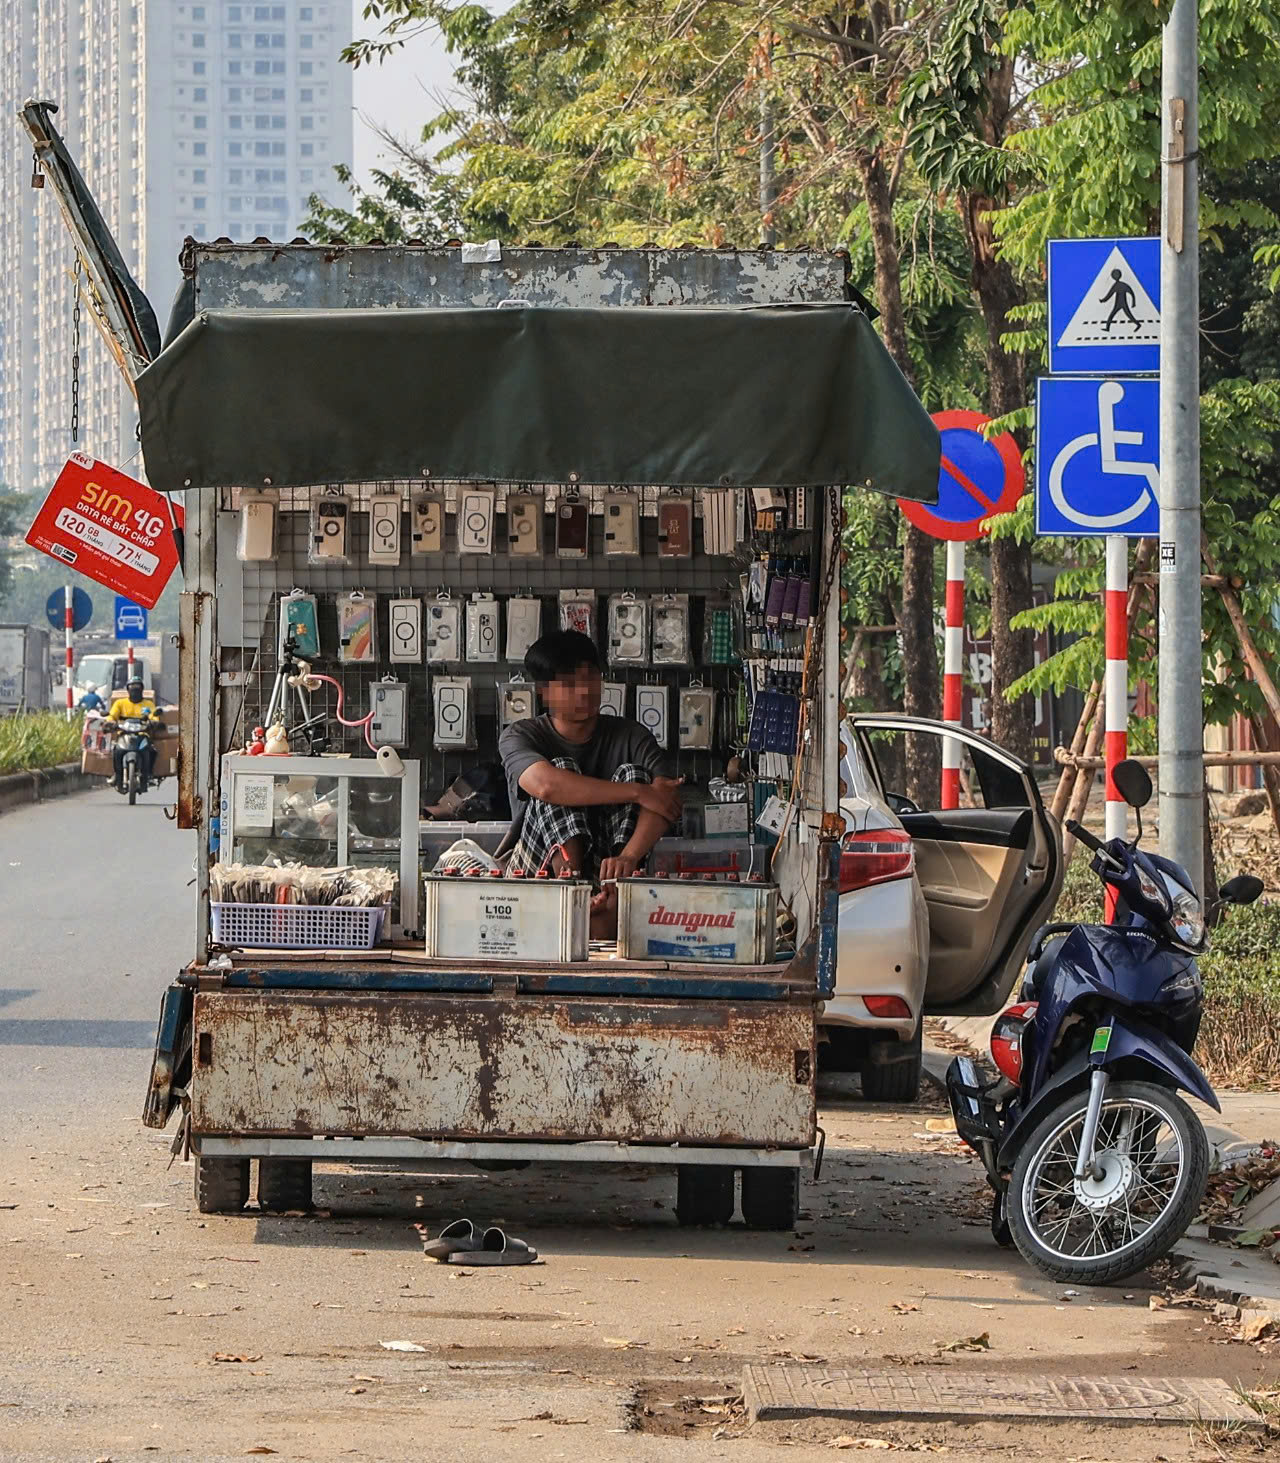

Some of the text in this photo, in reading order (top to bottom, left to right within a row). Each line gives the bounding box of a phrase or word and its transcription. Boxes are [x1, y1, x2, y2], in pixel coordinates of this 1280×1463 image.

[76, 501, 100, 520] DATA
[112, 522, 131, 536] BẤT
[81, 482, 164, 538] SIM 4G
[61, 514, 100, 537] 120 GB
[116, 542, 134, 560] 77
[1162, 548, 1174, 558] XE
[485, 905, 512, 915] L100
[648, 906, 736, 933] dongnai
[1126, 931, 1158, 945] HONDA
